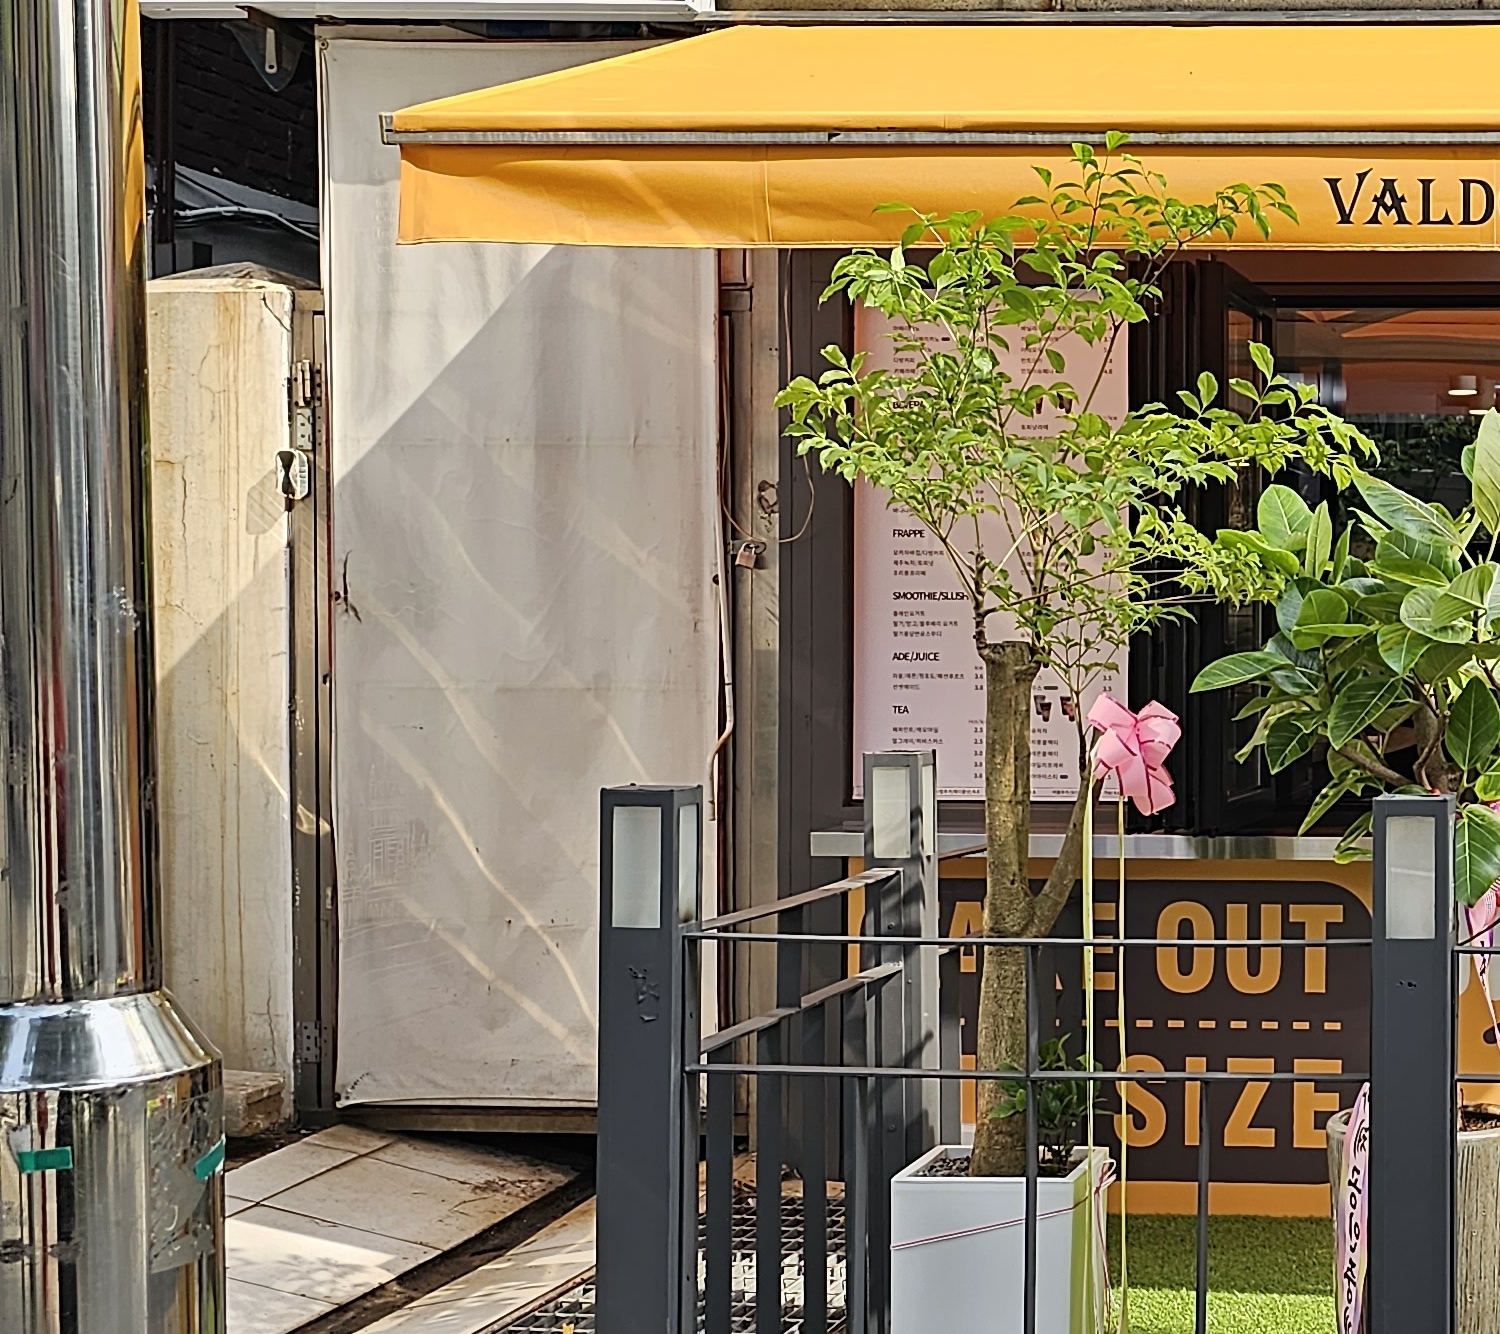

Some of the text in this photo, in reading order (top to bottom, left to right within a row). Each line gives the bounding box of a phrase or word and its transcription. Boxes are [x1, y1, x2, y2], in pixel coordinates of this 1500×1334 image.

[892, 529, 925, 538] FRAPPE
[892, 651, 940, 663] ADE/JUICE
[892, 705, 909, 714] TEA
[1156, 901, 1343, 994] OUT
[1114, 1054, 1342, 1148] SIZE
